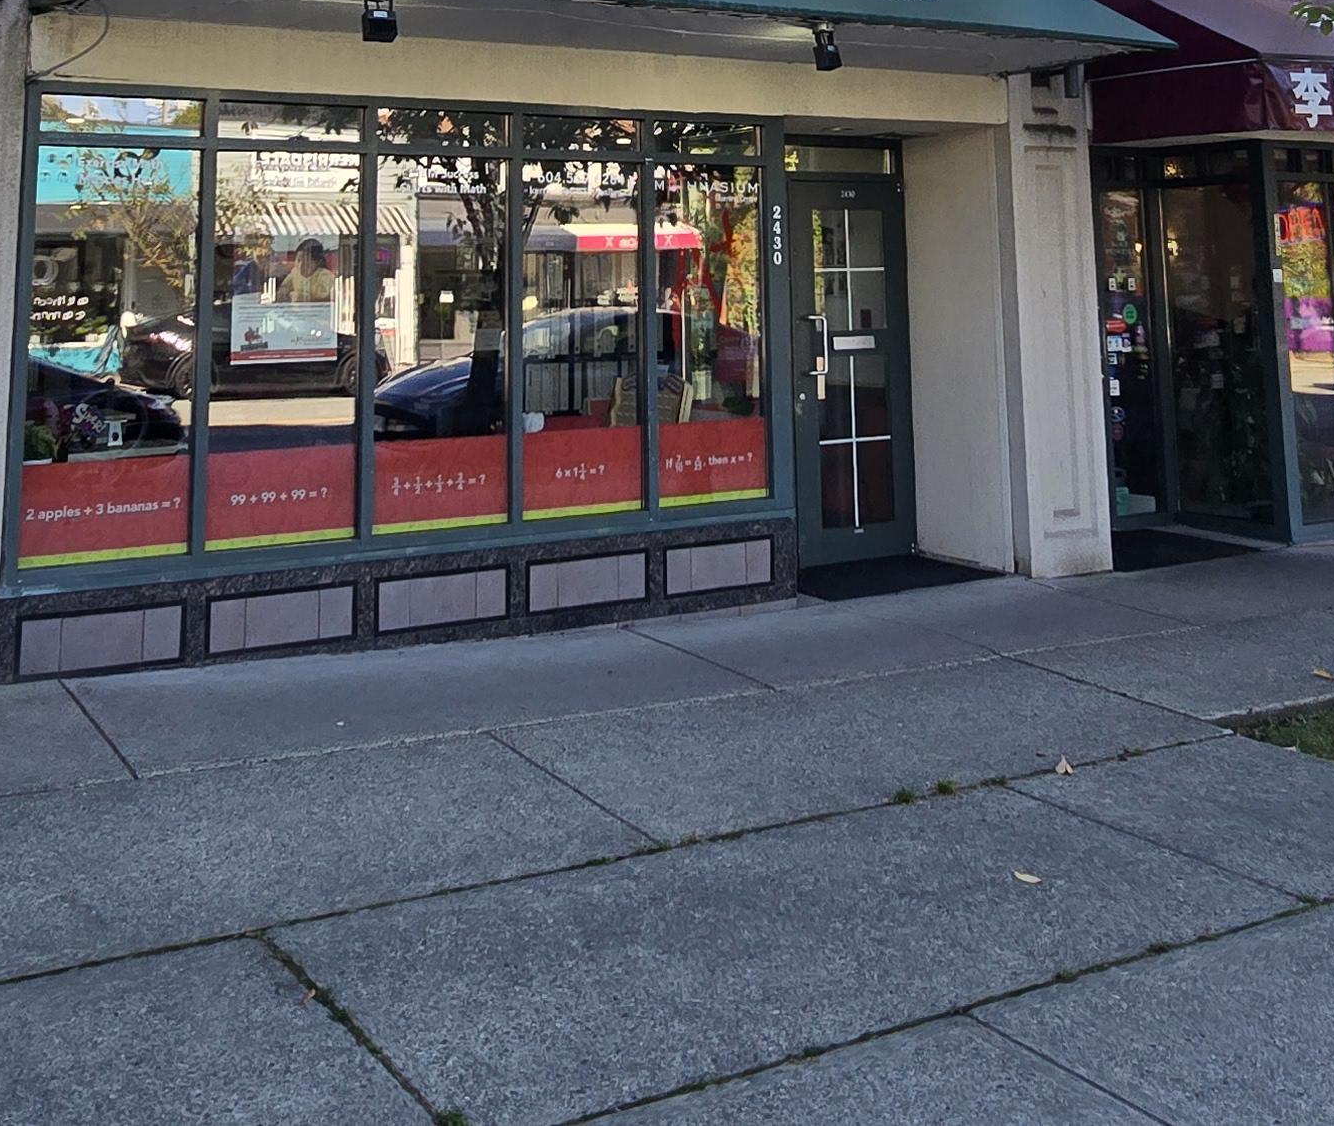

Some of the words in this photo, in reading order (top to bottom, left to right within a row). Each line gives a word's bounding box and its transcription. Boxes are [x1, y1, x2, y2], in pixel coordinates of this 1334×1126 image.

[772, 205, 783, 266] 2430
[555, 467, 562, 479] 6
[230, 493, 246, 506] 99
[260, 491, 277, 504] 99
[290, 488, 307, 501] 99
[320, 486, 328, 499] ?
[25, 508, 35, 521] 2
[38, 505, 81, 523] apples
[95, 503, 104, 515] 3
[107, 499, 159, 515] bananas
[173, 497, 181, 509] ?
